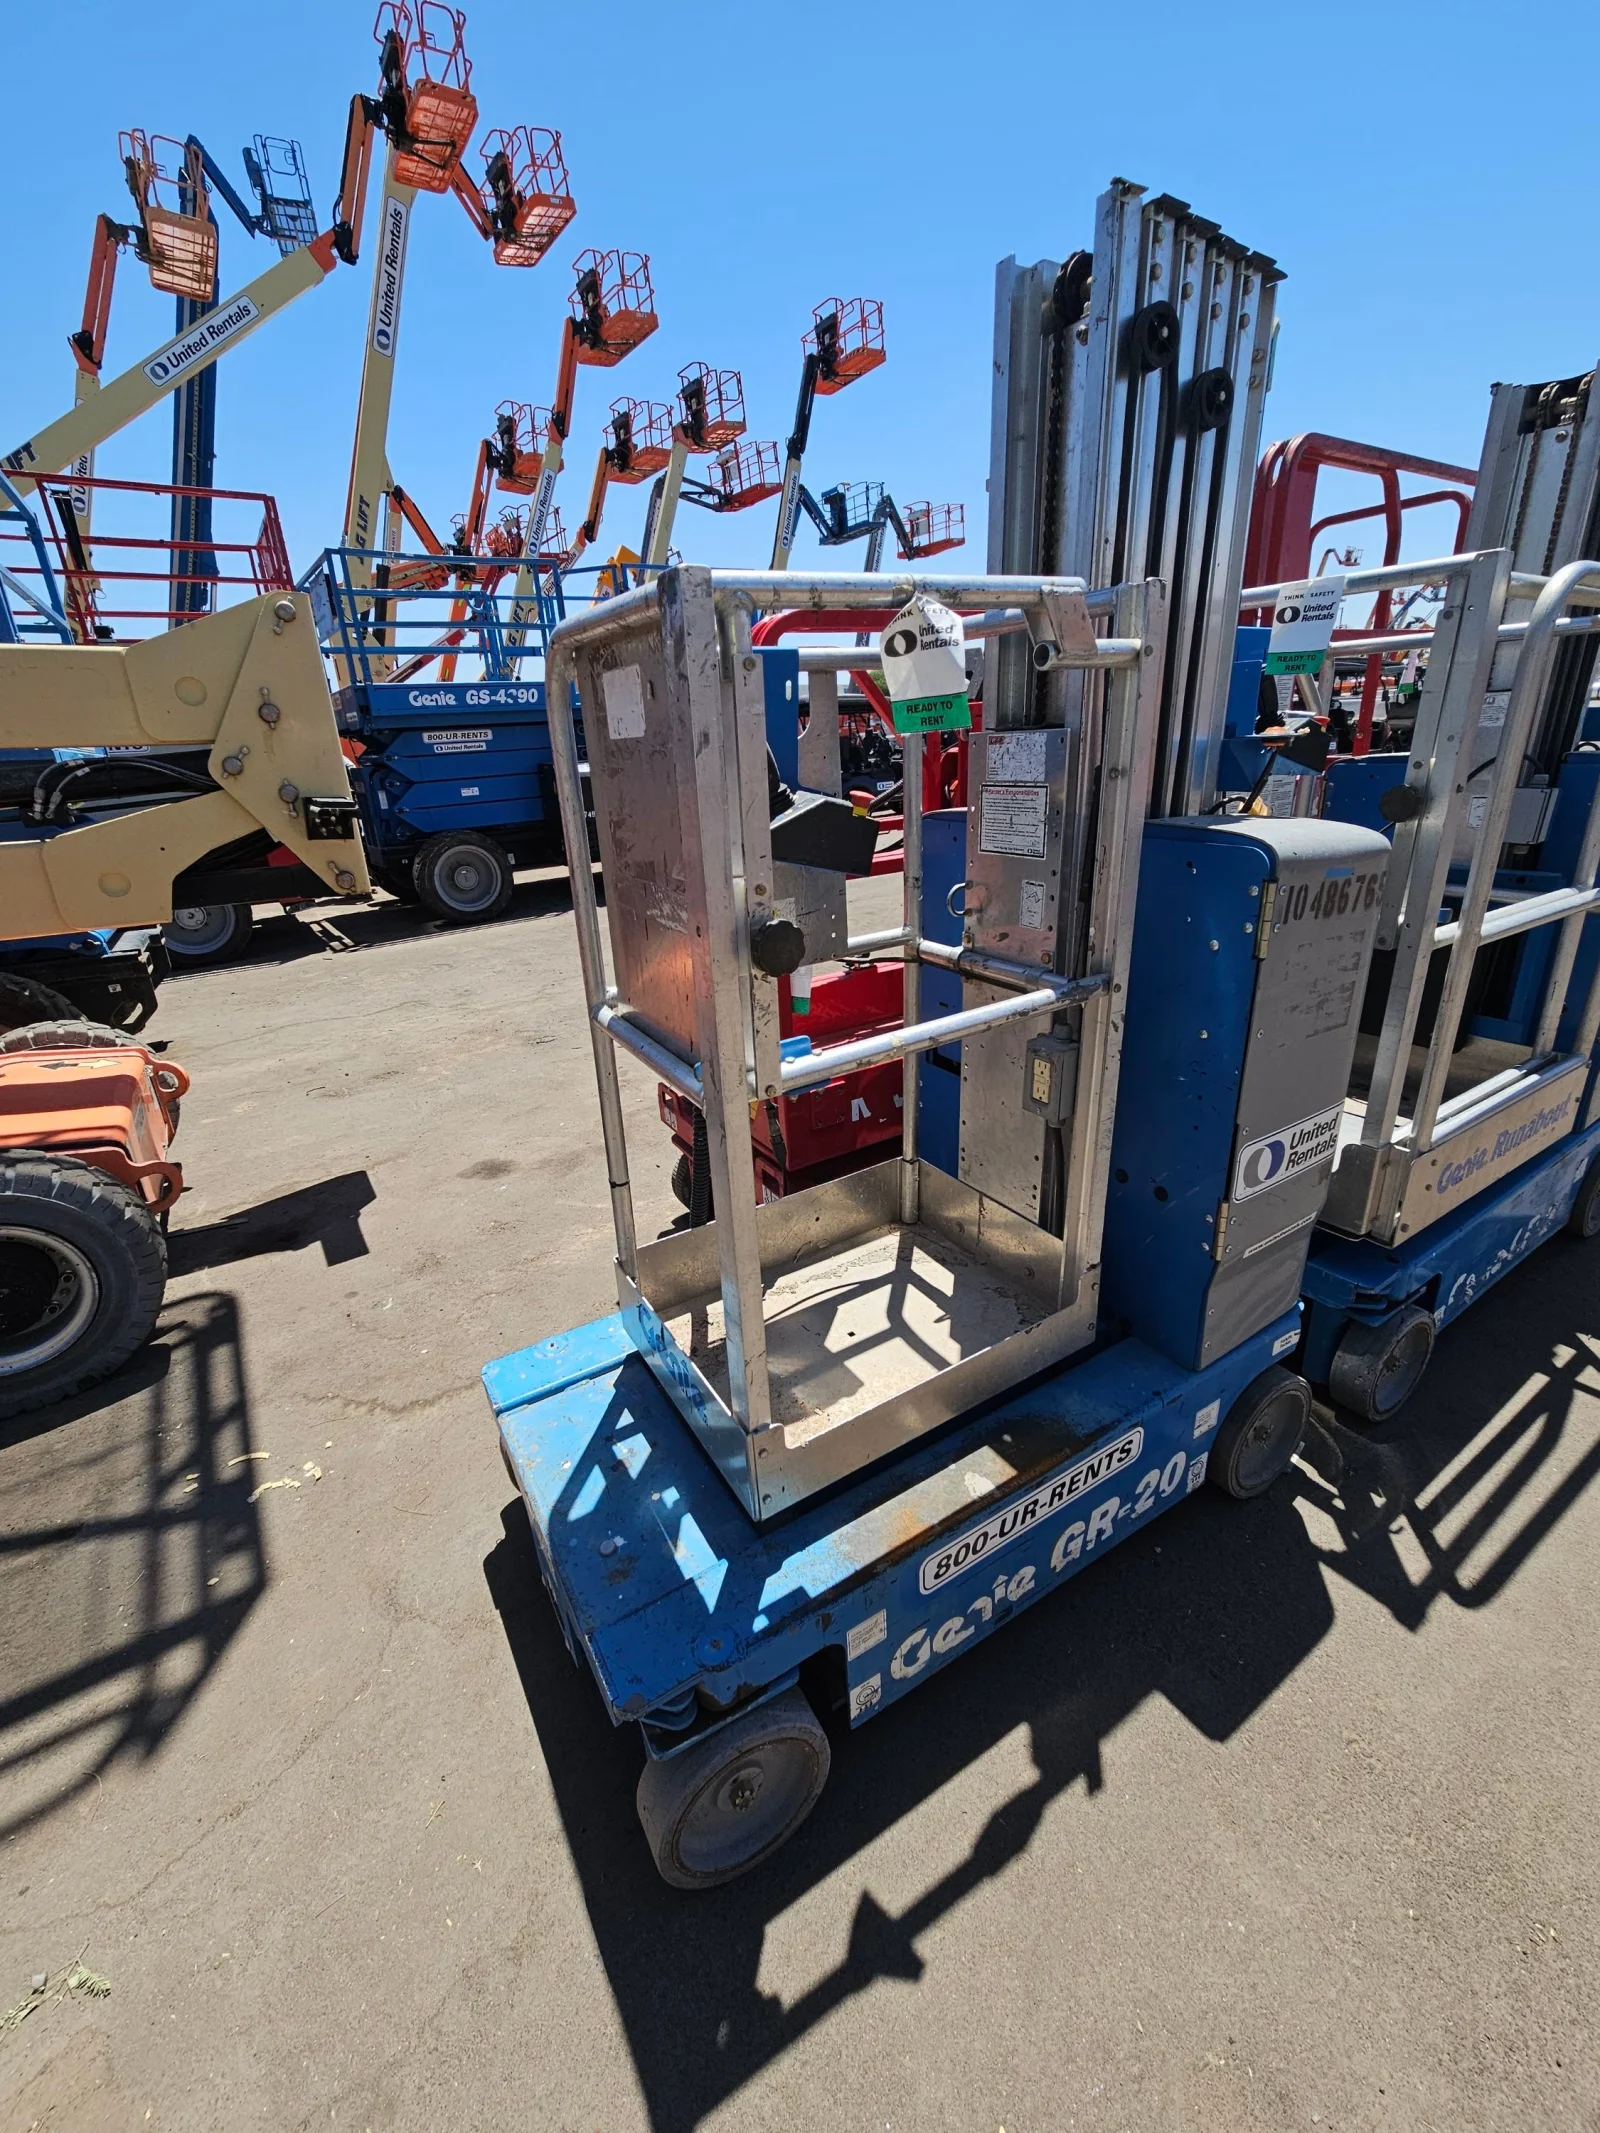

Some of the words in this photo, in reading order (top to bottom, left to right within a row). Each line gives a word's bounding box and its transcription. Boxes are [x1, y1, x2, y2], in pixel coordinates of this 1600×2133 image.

[385, 209, 403, 272] Rentals
[379, 269, 396, 328] United
[166, 331, 210, 369] United
[205, 304, 251, 341] Rentals
[0, 441, 36, 470] IFT
[788, 475, 798, 507] Rentals
[356, 494, 370, 534] LIFT
[532, 508, 546, 542] United
[539, 473, 554, 511] Rentals
[784, 509, 793, 536] United
[1284, 593, 1305, 601] THINK
[1310, 590, 1336, 598] SAFETY
[1303, 602, 1336, 613] United
[1300, 611, 1335, 623] Rentals
[920, 637, 960, 651] Rentals
[408, 690, 457, 706] Genie
[906, 701, 940, 715] READY
[941, 700, 953, 710] TO
[427, 731, 489, 741] 800-UR-RENTS
[920, 715, 945, 727] RENT
[1289, 1112, 1340, 1151] United
[1436, 1148, 1489, 1195] Genie
[1489, 1092, 1572, 1165] Runabout
[1284, 1132, 1338, 1172] Rentals
[932, 1438, 1134, 1581] 800-UR-RENTS
[1050, 1450, 1187, 1573] GR-20
